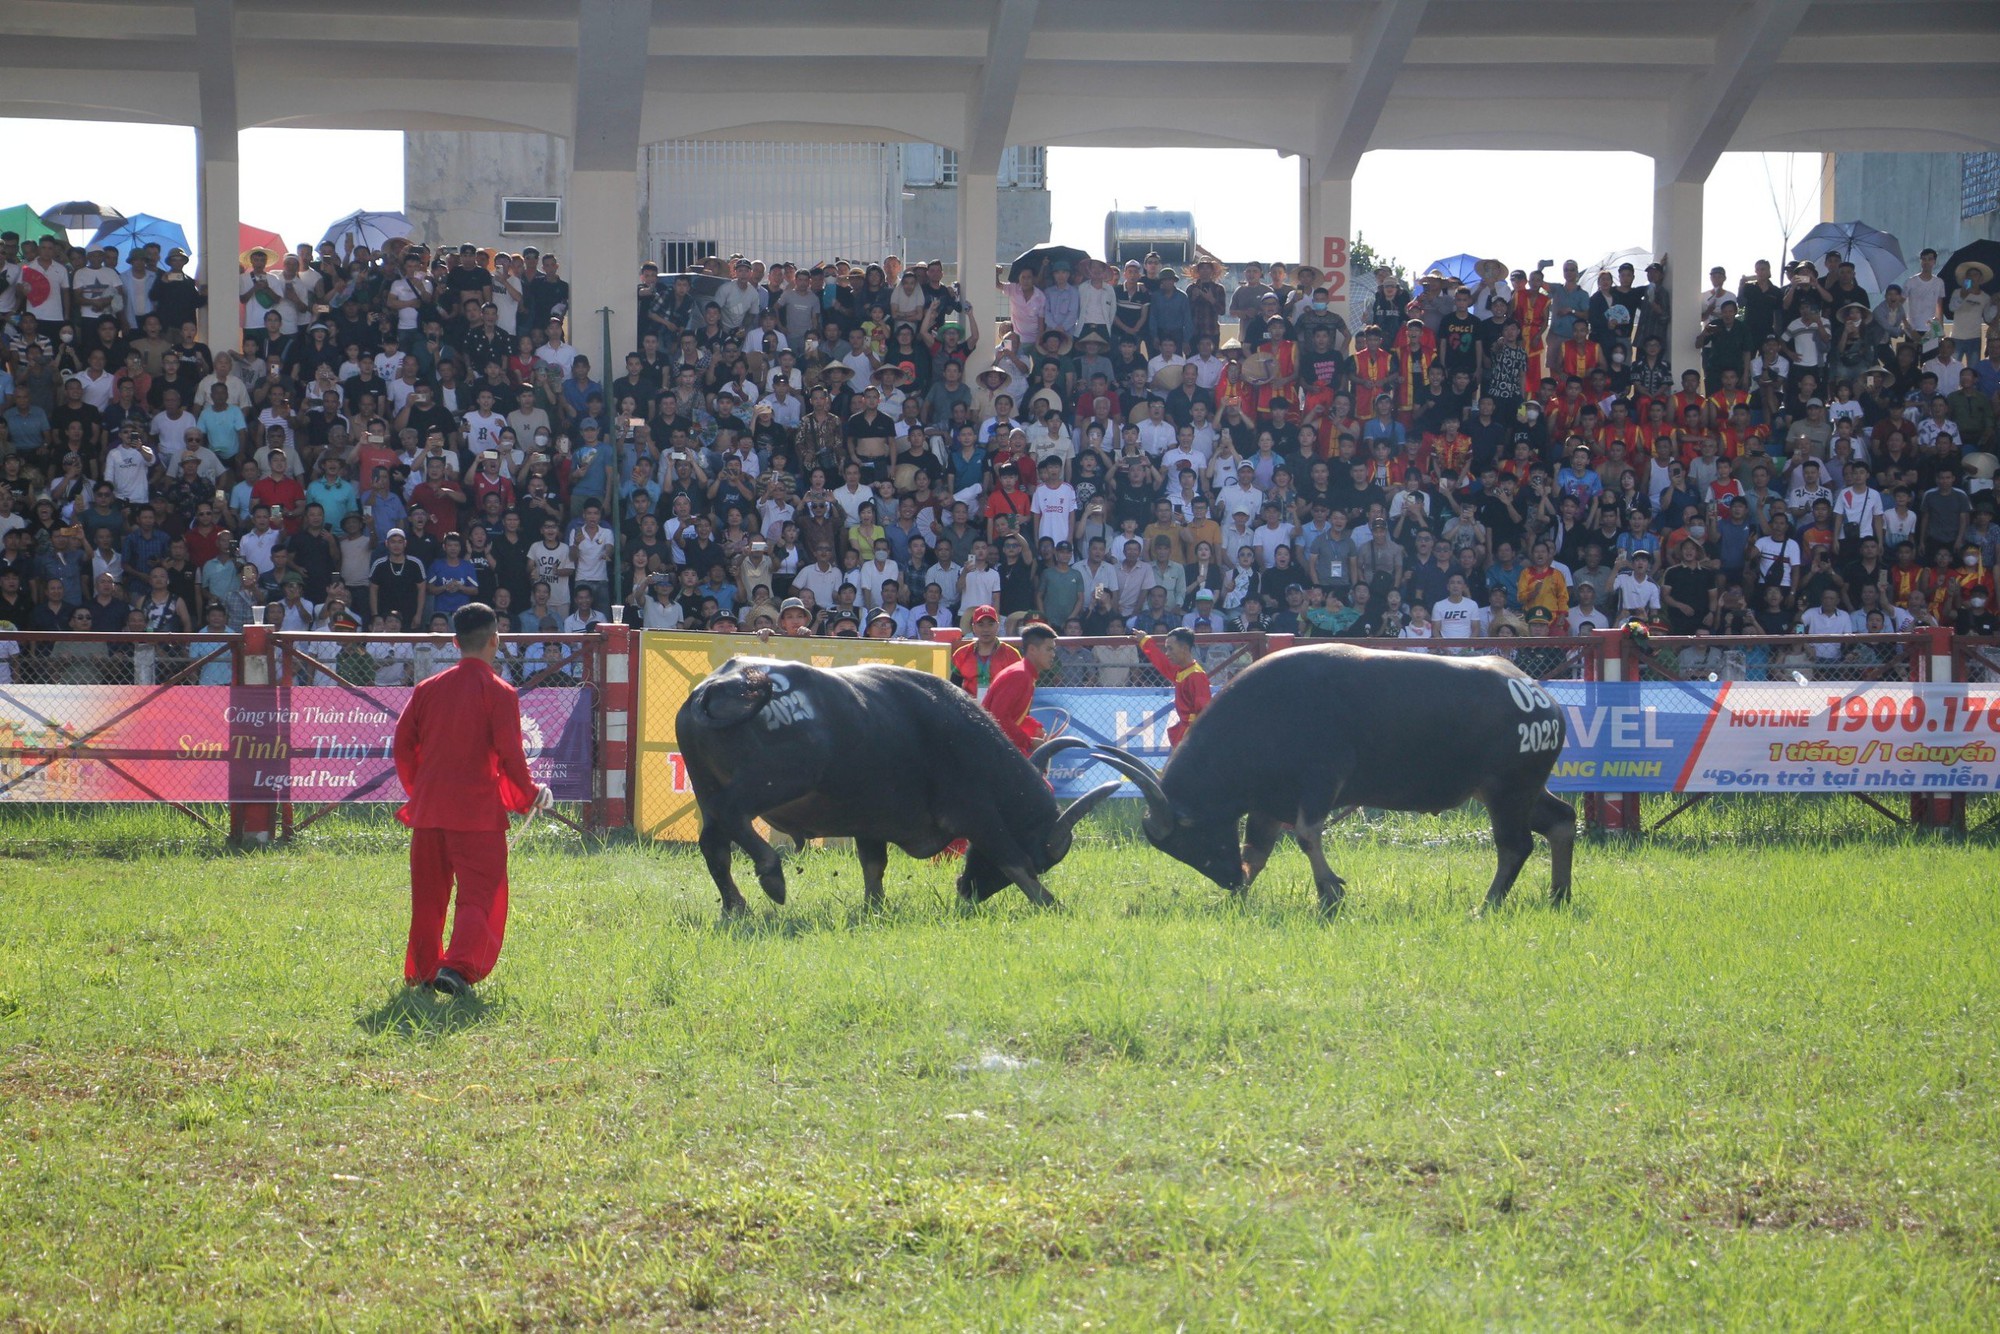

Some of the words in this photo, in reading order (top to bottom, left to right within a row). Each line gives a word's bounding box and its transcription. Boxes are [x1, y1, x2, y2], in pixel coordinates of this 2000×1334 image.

[539, 556, 562, 567] ICON
[1444, 610, 1468, 620] UFC
[1508, 677, 1551, 713] 05
[224, 706, 265, 727] Công
[269, 707, 298, 723] viên
[303, 706, 344, 723] Thần
[347, 707, 388, 727] thoại
[1563, 706, 1674, 748] VEL
[1730, 710, 1811, 727] HOTLINE
[1518, 719, 1559, 752] 2023
[176, 734, 222, 759] Sơn
[231, 735, 288, 759] Tinh
[310, 735, 372, 765] Thủy
[1770, 743, 1783, 761] 1
[1786, 740, 1858, 765] tiếng
[1879, 743, 1893, 762] 1
[1896, 740, 1996, 766] chuyến
[531, 770, 567, 779] OCEAN
[1602, 761, 1662, 777] NINH
[1777, 767, 1815, 785] trả
[1823, 769, 1858, 789] tại
[1865, 769, 1916, 786] nhà
[1922, 766, 1988, 786] miễn
[254, 770, 315, 791] Legend
[318, 771, 358, 787] Park
